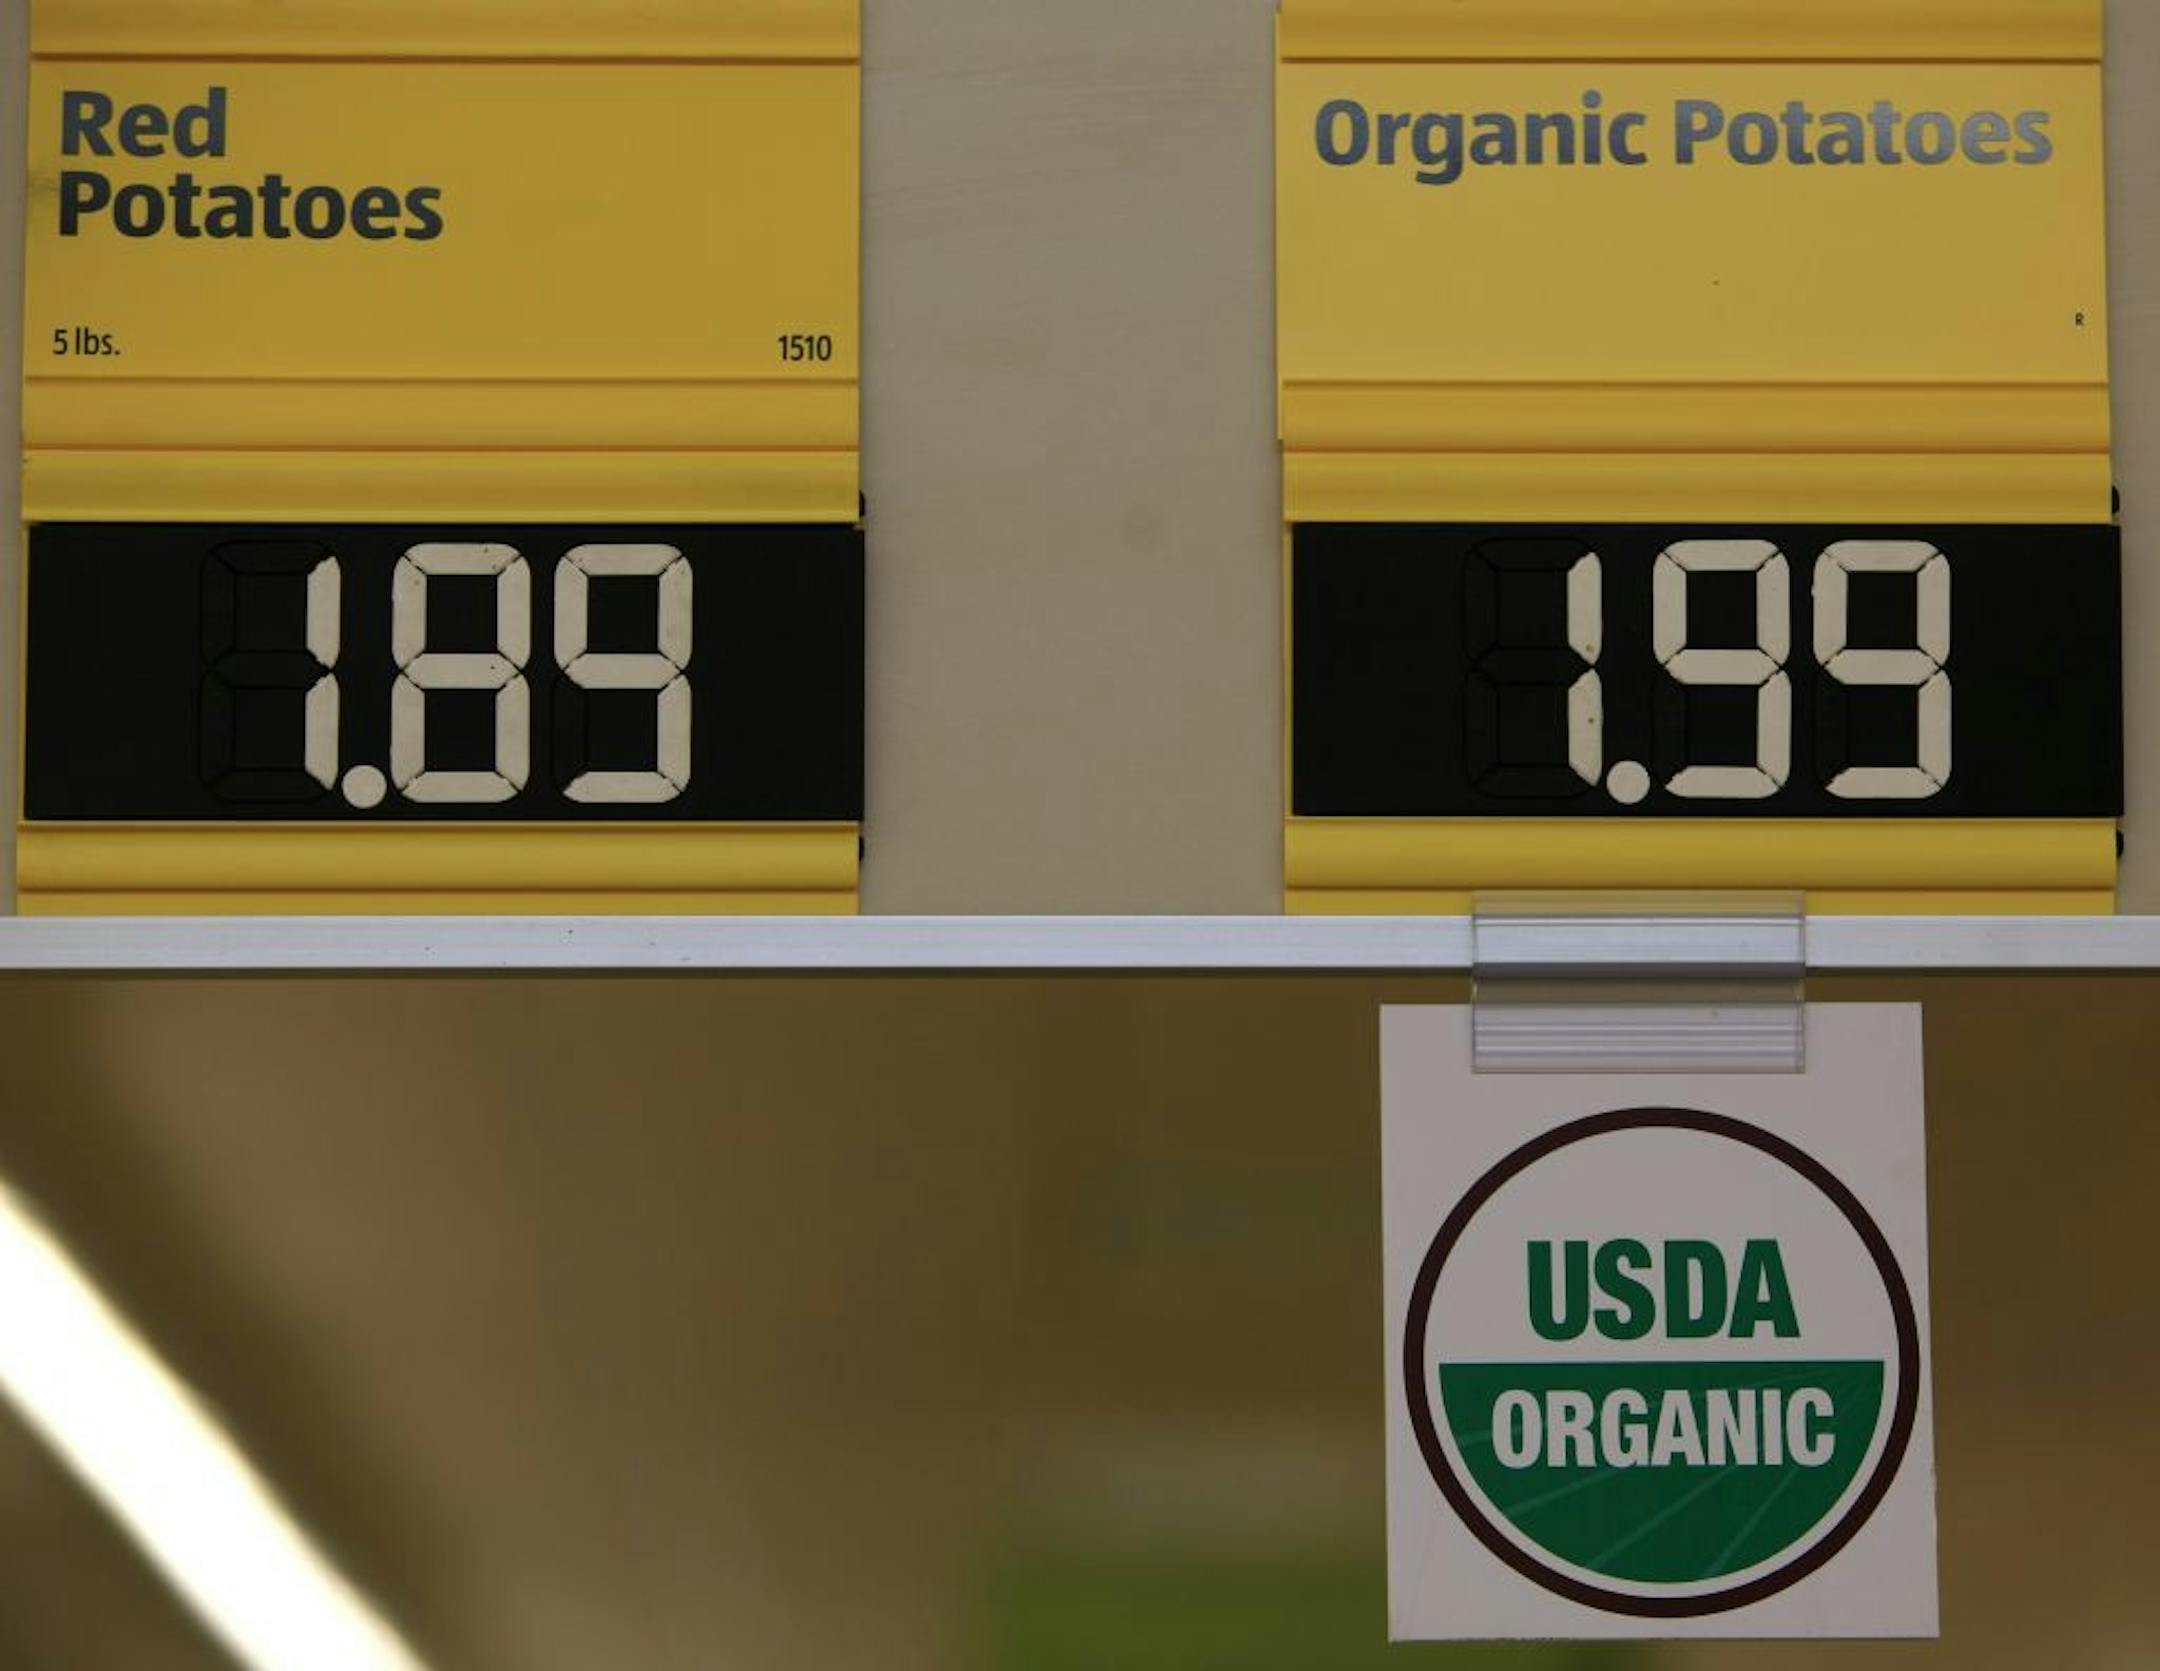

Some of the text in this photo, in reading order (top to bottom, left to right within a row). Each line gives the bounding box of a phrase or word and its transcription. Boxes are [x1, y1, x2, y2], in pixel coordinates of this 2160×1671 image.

[61, 87, 229, 157] Red
[1314, 89, 2054, 187] Organic Potatoes
[58, 170, 444, 241] Potatoes
[53, 326, 121, 356] 5 lbs.
[777, 335, 833, 363] 1510
[305, 542, 694, 810] 1.89
[1566, 539, 1953, 805] 1.99
[1526, 1238, 1801, 1341] USDA
[1491, 1387, 1836, 1468] ORGANIC
